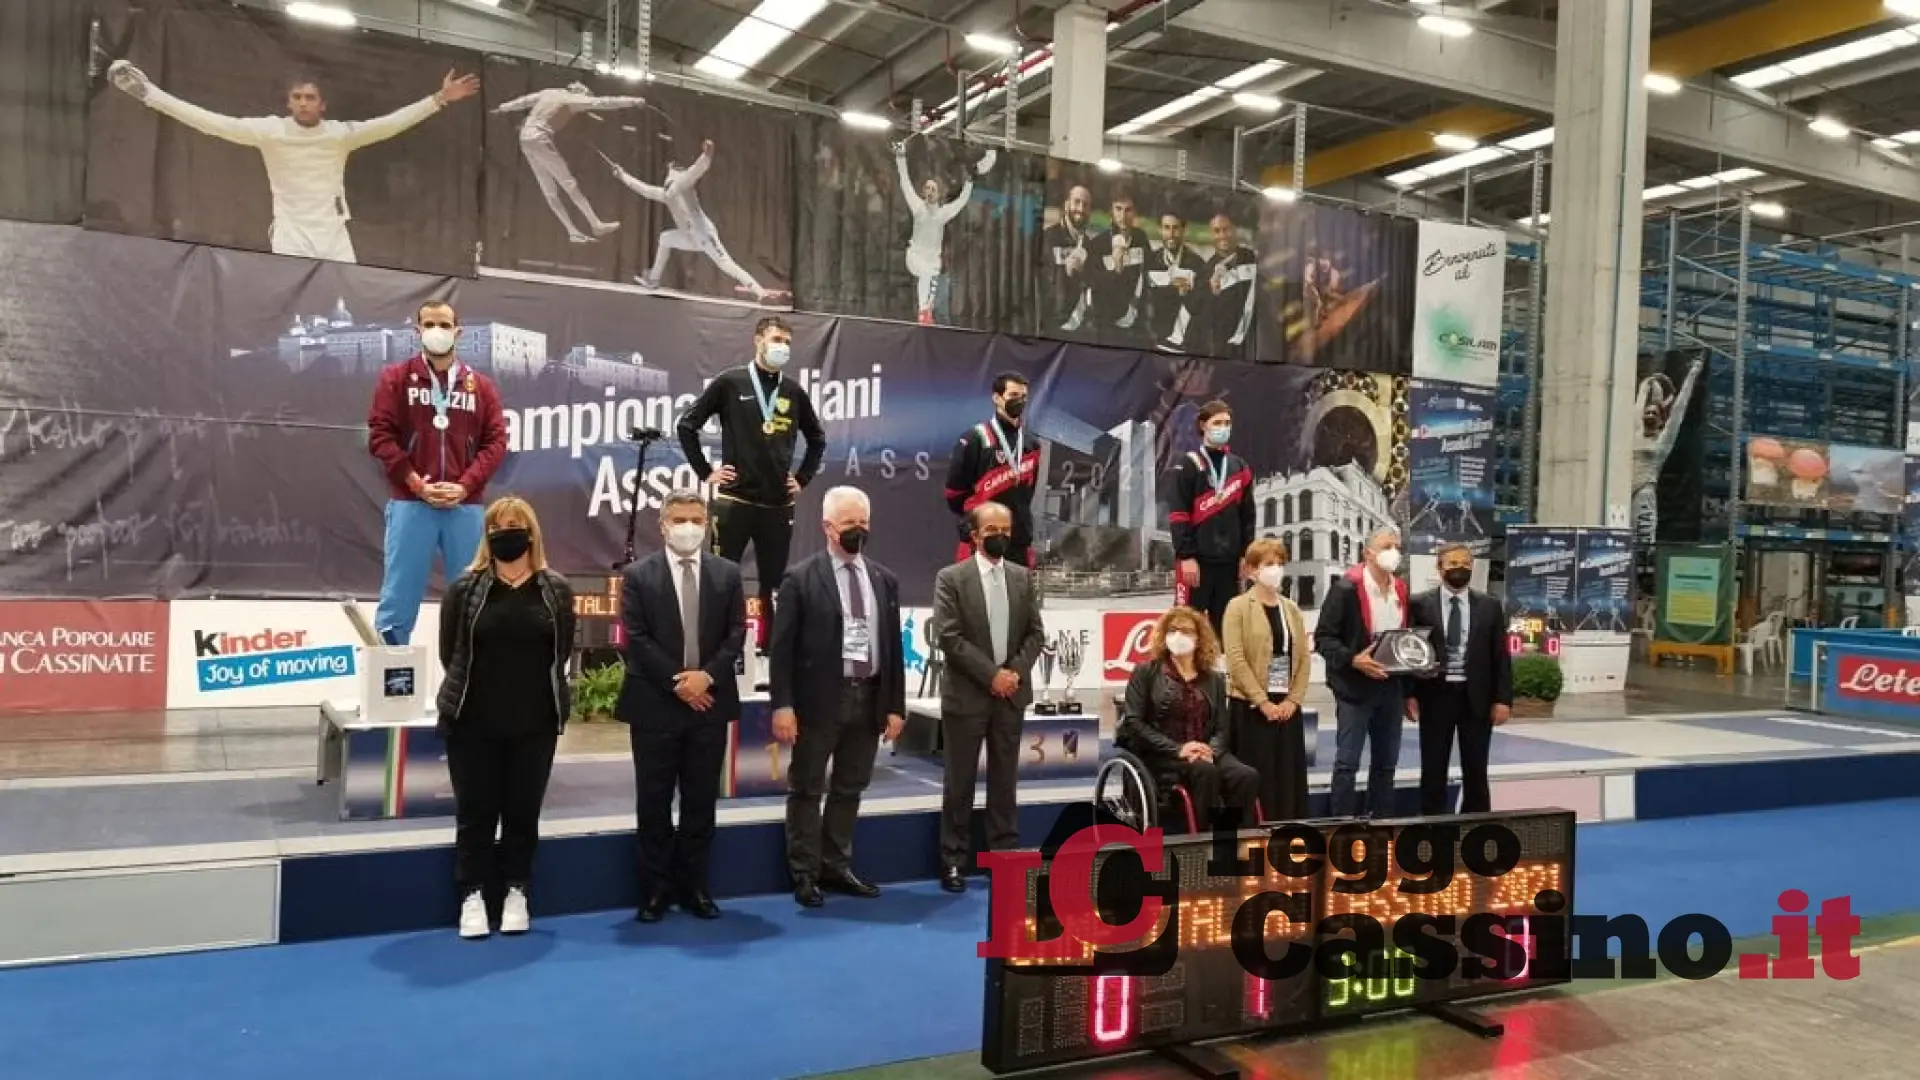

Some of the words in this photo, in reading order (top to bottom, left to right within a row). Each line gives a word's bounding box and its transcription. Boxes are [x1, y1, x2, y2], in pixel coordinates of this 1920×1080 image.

[800, 363, 882, 421] liani
[52, 626, 156, 648] POPOLARE
[10, 648, 156, 675] CASSINATE
[205, 663, 244, 685] Joy
[249, 657, 271, 678] of
[276, 653, 348, 676] moving
[1840, 663, 1920, 696] Lete
